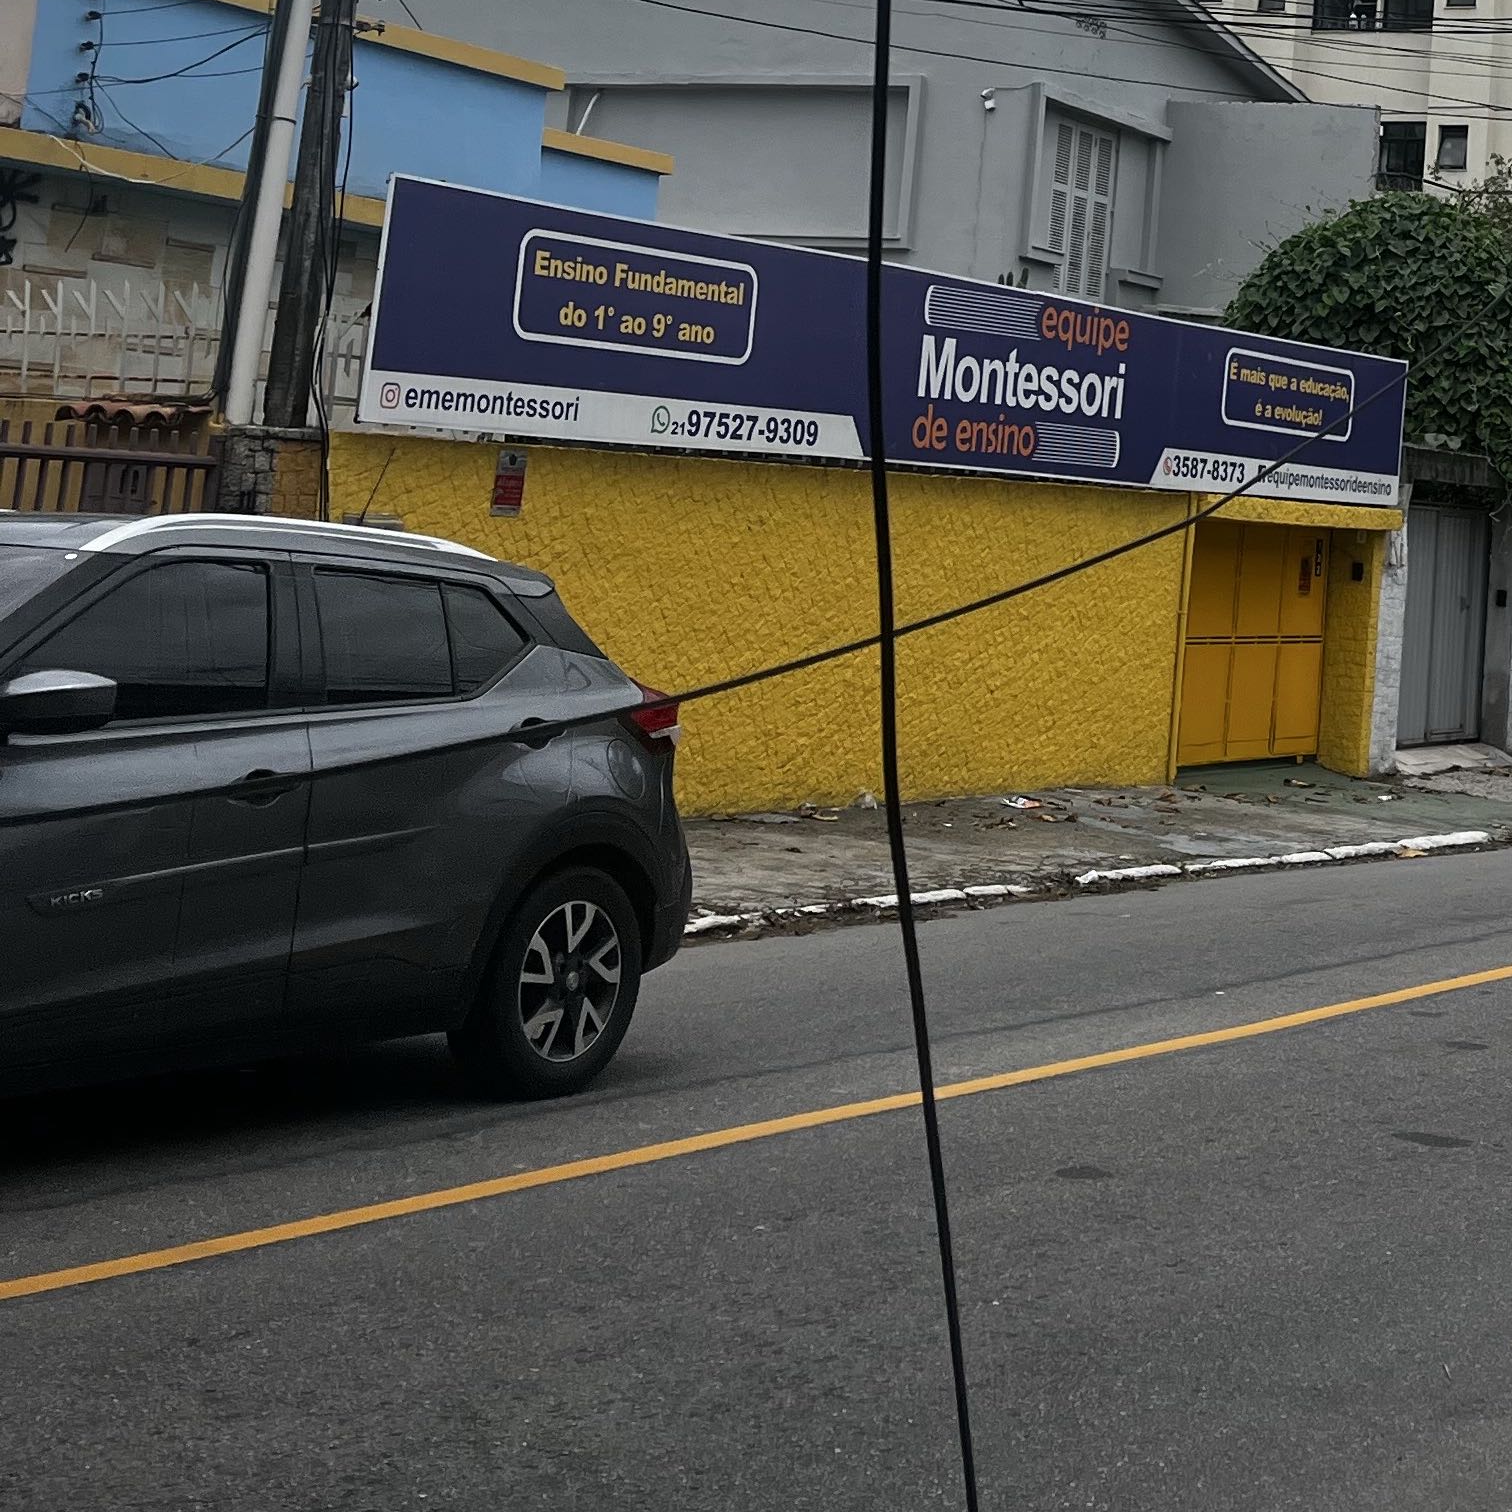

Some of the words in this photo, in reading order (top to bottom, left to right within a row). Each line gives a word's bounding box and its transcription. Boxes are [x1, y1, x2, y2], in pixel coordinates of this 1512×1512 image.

[534, 250, 608, 285] Ensino
[614, 263, 744, 305] Fundamental
[559, 301, 587, 328] do
[619, 314, 646, 335] ao
[678, 321, 715, 344] ano
[1042, 305, 1130, 356] equipe
[917, 334, 1127, 419] Montessori
[1230, 358, 1239, 380] É
[1240, 367, 1266, 386] mais
[1269, 373, 1287, 392] que
[1290, 377, 1297, 391] a
[1299, 377, 1350, 403] educação,
[404, 388, 580, 421] ememontessori
[1255, 399, 1263, 416] é
[1264, 404, 1272, 418] a
[1274, 405, 1323, 427] evolução!
[671, 421, 685, 436] 21
[687, 409, 819, 447] 97527-9309
[912, 403, 948, 450] de
[955, 414, 1035, 457] ensino
[1172, 455, 1245, 484] 3587-8373
[50, 889, 103, 906] KICKS
